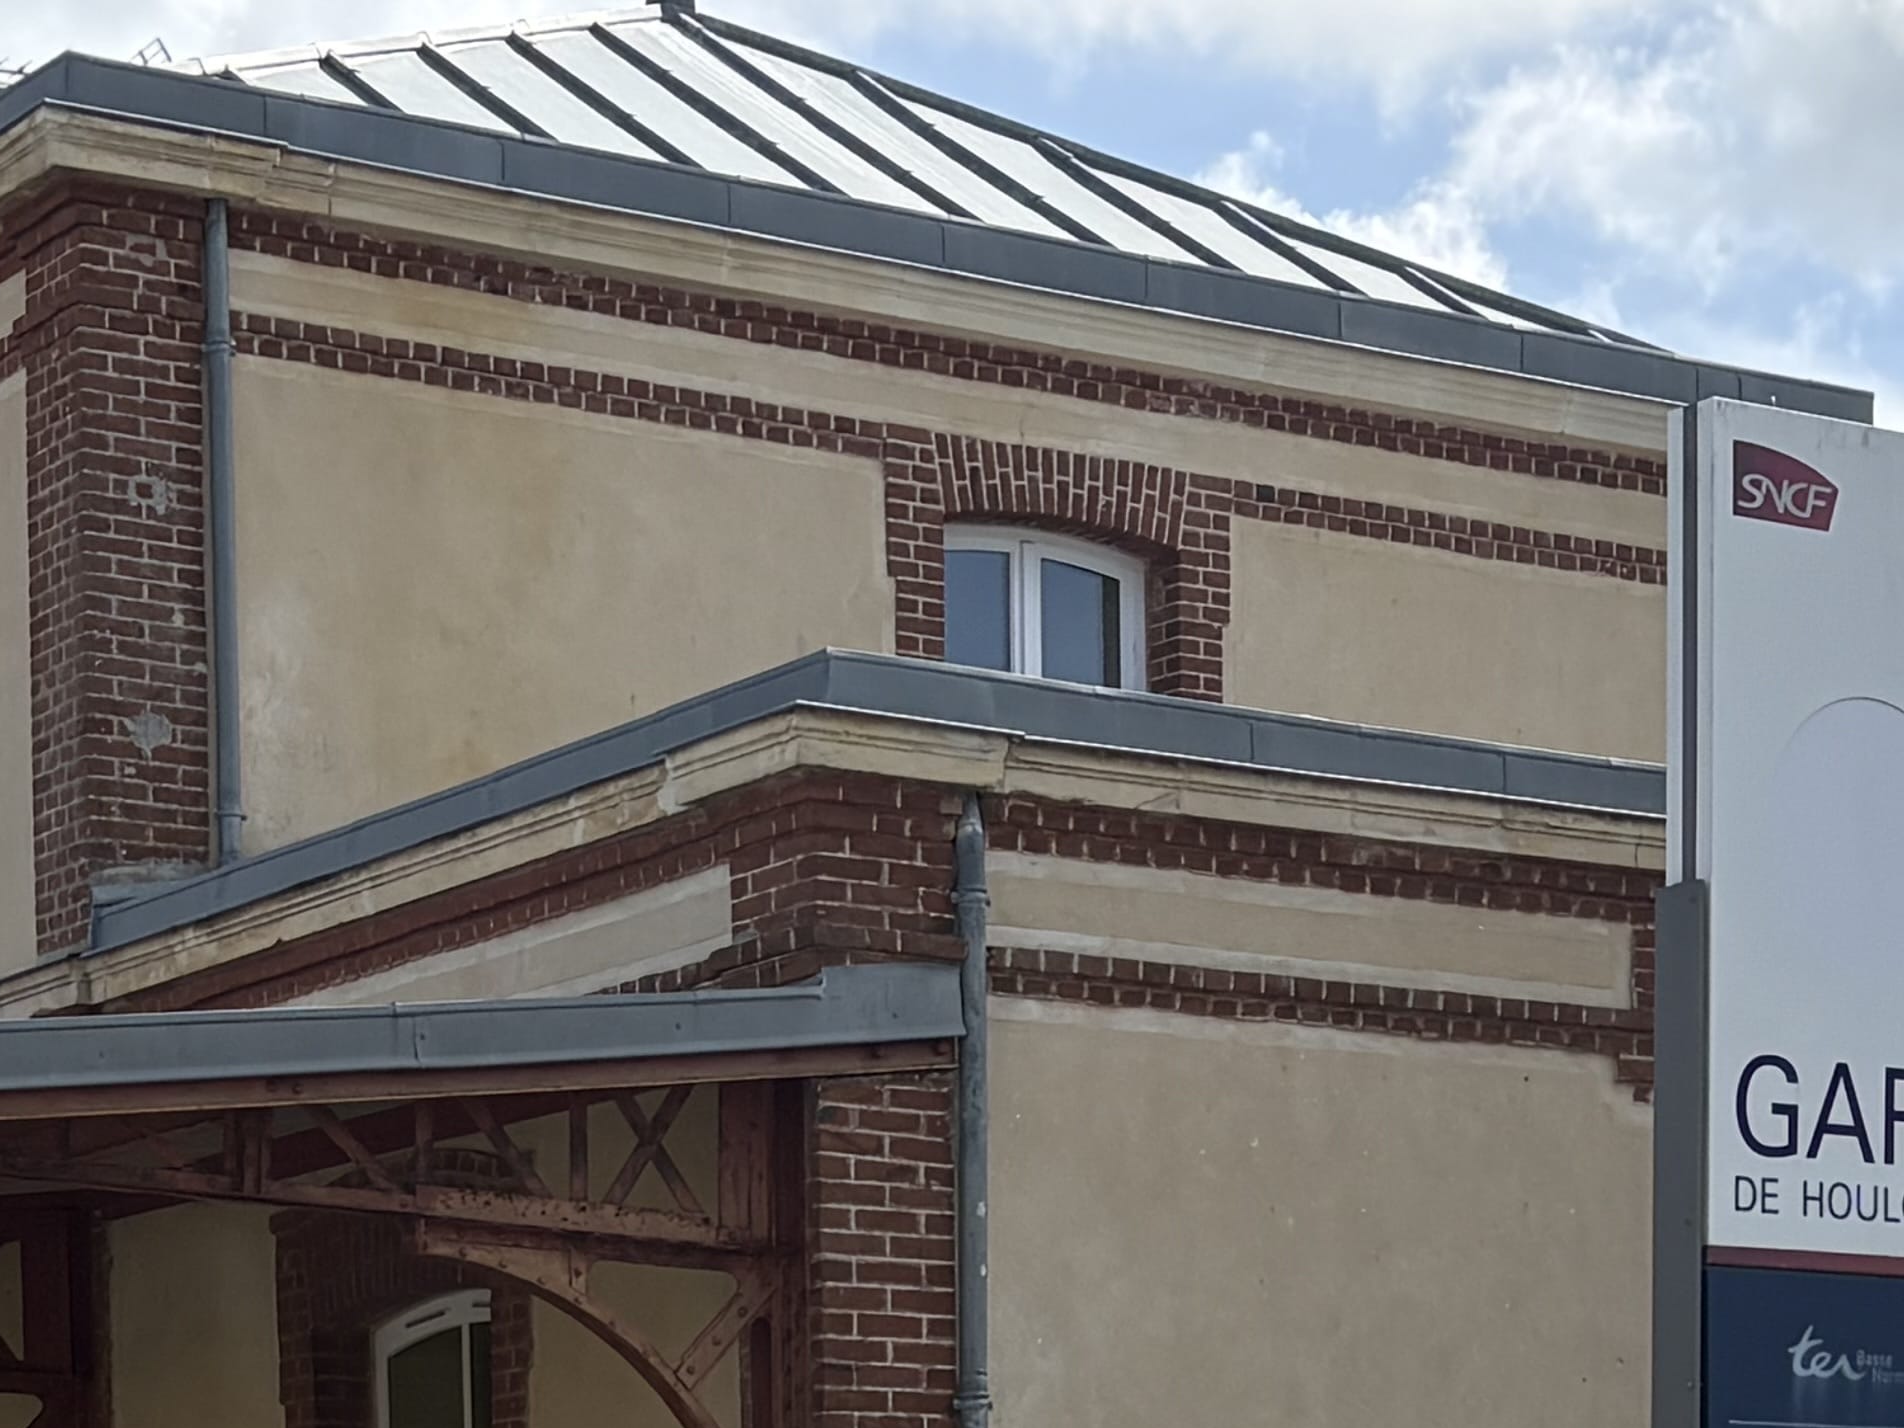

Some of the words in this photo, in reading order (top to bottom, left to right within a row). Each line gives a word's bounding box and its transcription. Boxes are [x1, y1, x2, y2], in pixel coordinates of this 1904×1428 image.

[1737, 473, 1833, 519] SNCF
[1734, 1175, 1779, 1215] DE
[1786, 1324, 1866, 1381] ter
